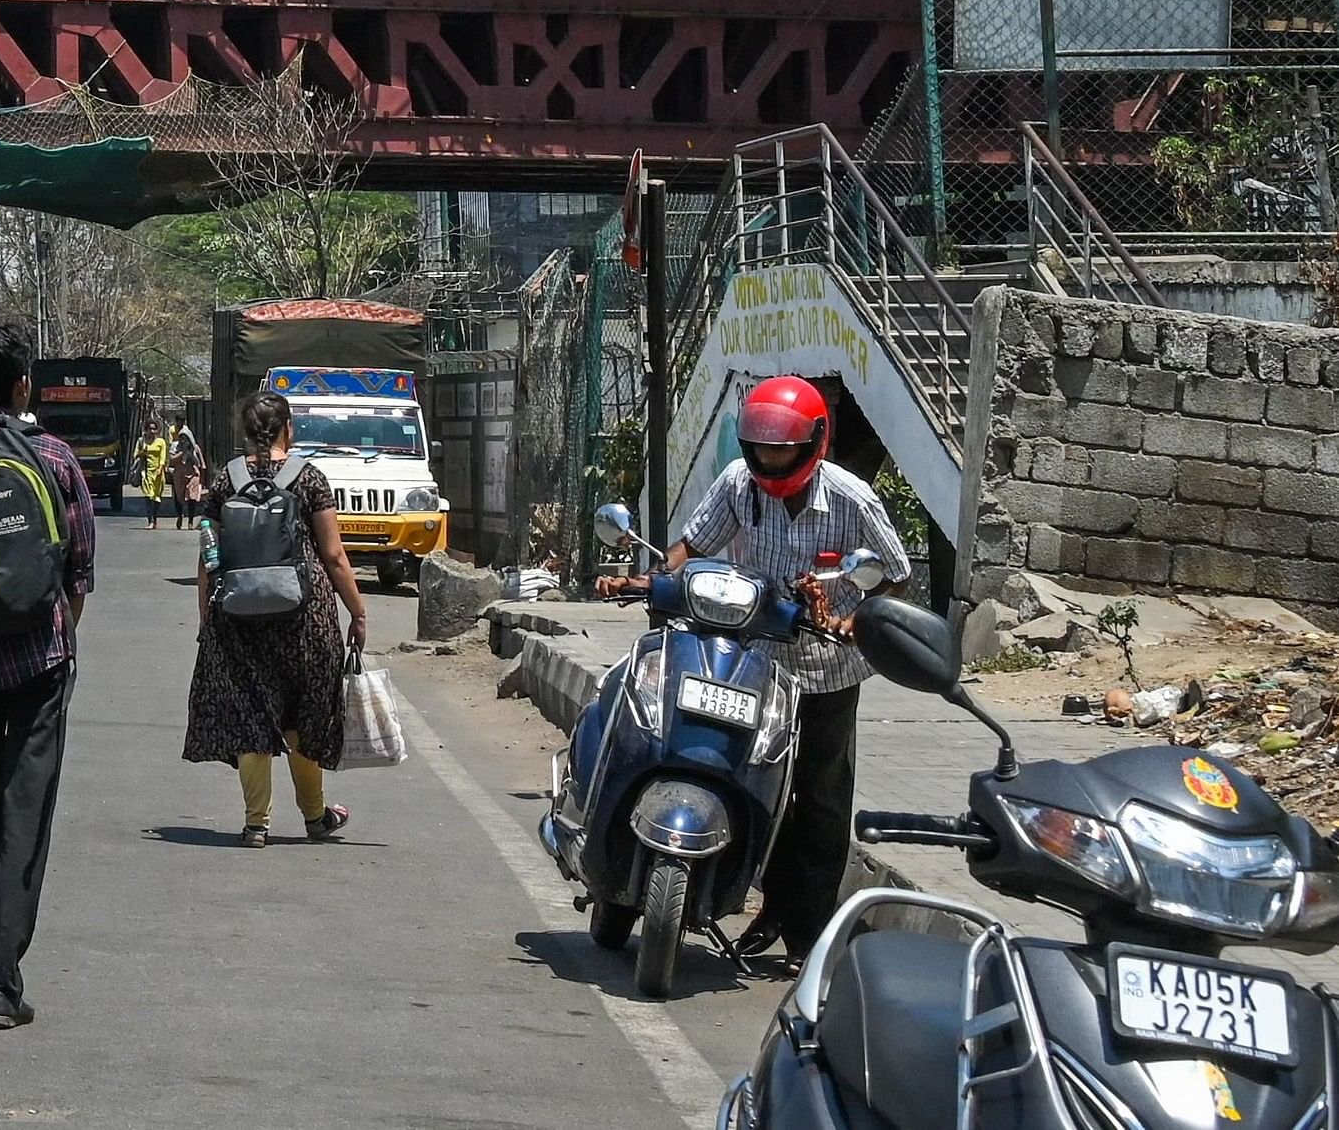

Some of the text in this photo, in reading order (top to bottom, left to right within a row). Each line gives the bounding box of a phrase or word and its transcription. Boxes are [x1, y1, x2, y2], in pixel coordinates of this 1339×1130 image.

[733, 269, 826, 310] VOTING IS NOT ONLY
[721, 317, 742, 356] OUR
[786, 311, 796, 348] IS
[798, 306, 821, 346] OUR
[823, 306, 868, 385] POWER
[1123, 986, 1144, 998] IND
[1150, 961, 1257, 1012] KA05K
[1152, 1000, 1257, 1049] J2731
